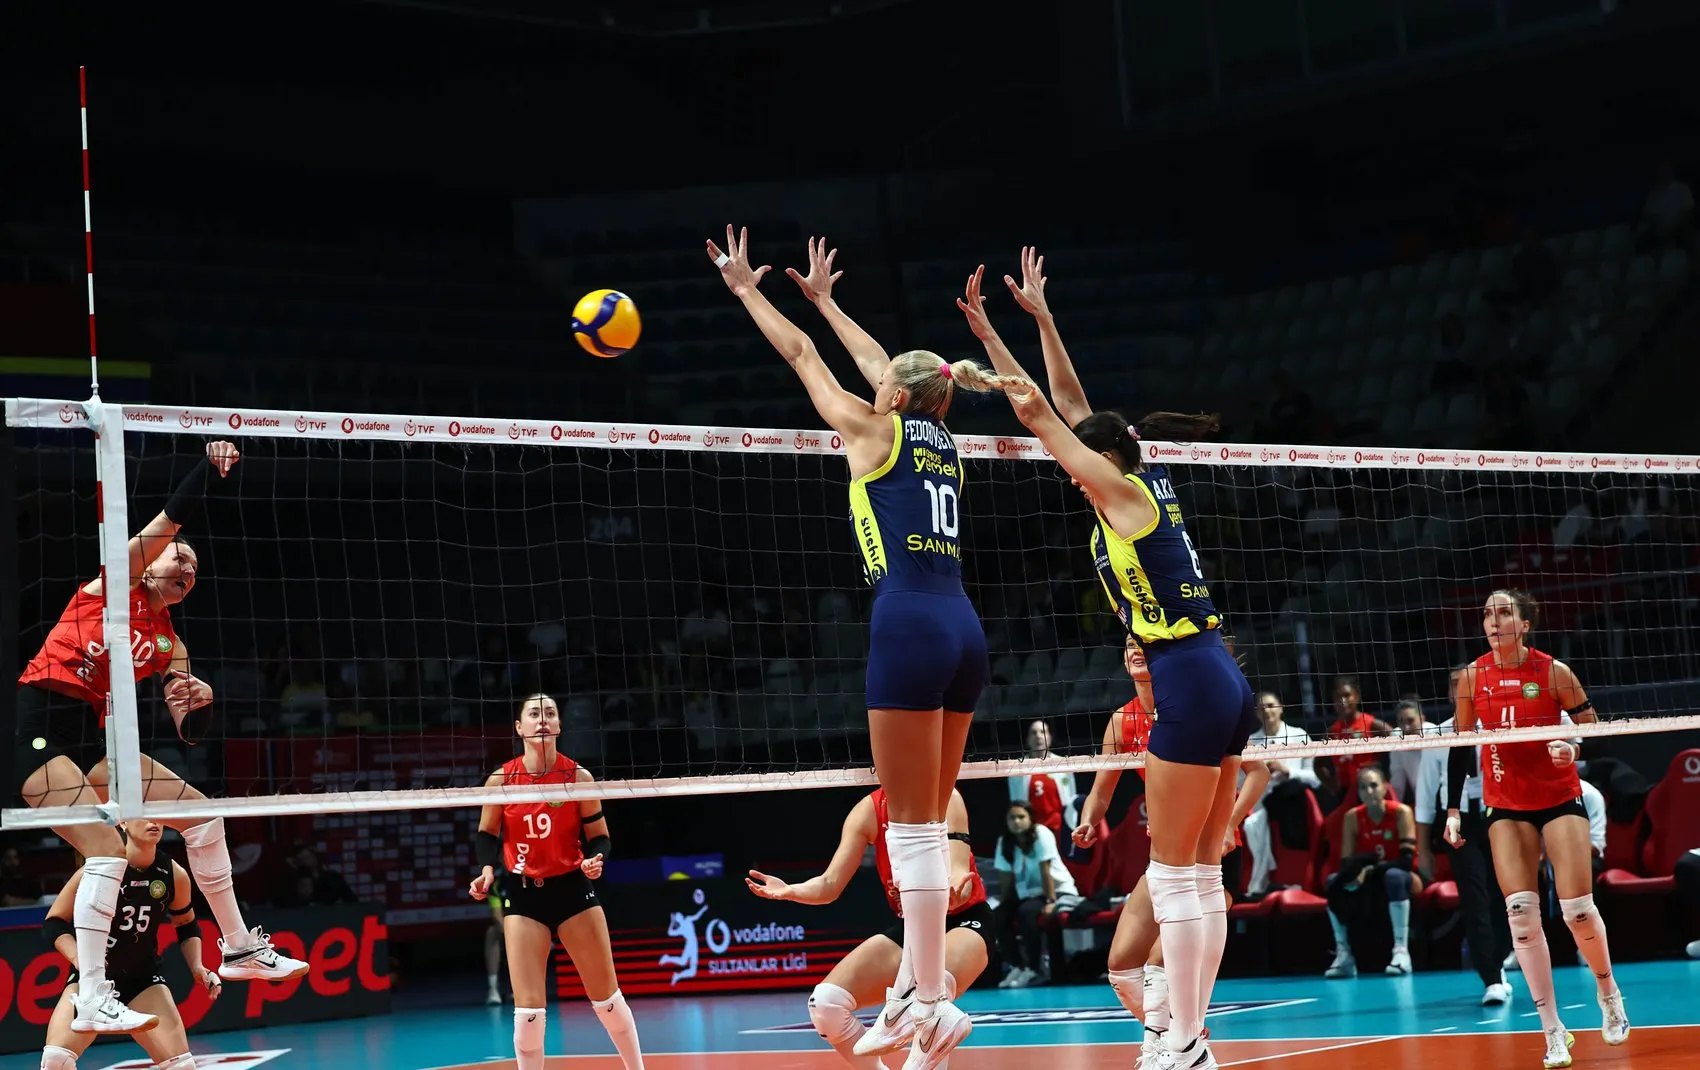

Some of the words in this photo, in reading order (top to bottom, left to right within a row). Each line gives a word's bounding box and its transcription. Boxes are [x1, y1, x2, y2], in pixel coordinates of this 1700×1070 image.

[75, 411, 89, 420] TV
[125, 412, 163, 422] vodafone
[194, 416, 213, 426] TVF
[243, 417, 280, 427] vodafone
[309, 421, 327, 431] TVF
[355, 422, 390, 431] vodafone
[418, 425, 434, 434] TVF
[461, 425, 495, 435] vodafone
[522, 428, 538, 437] TVF
[563, 429, 595, 438] vodafone
[620, 432, 636, 441] TVF
[660, 433, 691, 442] vodafone
[714, 436, 730, 445] TVF
[753, 436, 782, 445] vodafone
[805, 438, 819, 447] TVF
[973, 443, 987, 451] TVF
[1007, 443, 1032, 452] vodafone
[1158, 447, 1182, 456] vodafone
[1200, 450, 1211, 458] TVF
[1230, 450, 1252, 458] vodafone
[1297, 452, 1319, 460] vodafone
[1363, 453, 1383, 461] vodafone
[1425, 455, 1445, 463] vodafone
[913, 456, 957, 478] yemek
[924, 480, 958, 538] 10
[1489, 744, 1505, 783] ovido
[522, 812, 552, 840] 19
[119, 905, 152, 933] 35
[733, 922, 805, 943] vodafone
[708, 957, 778, 974] SULTANLAR
